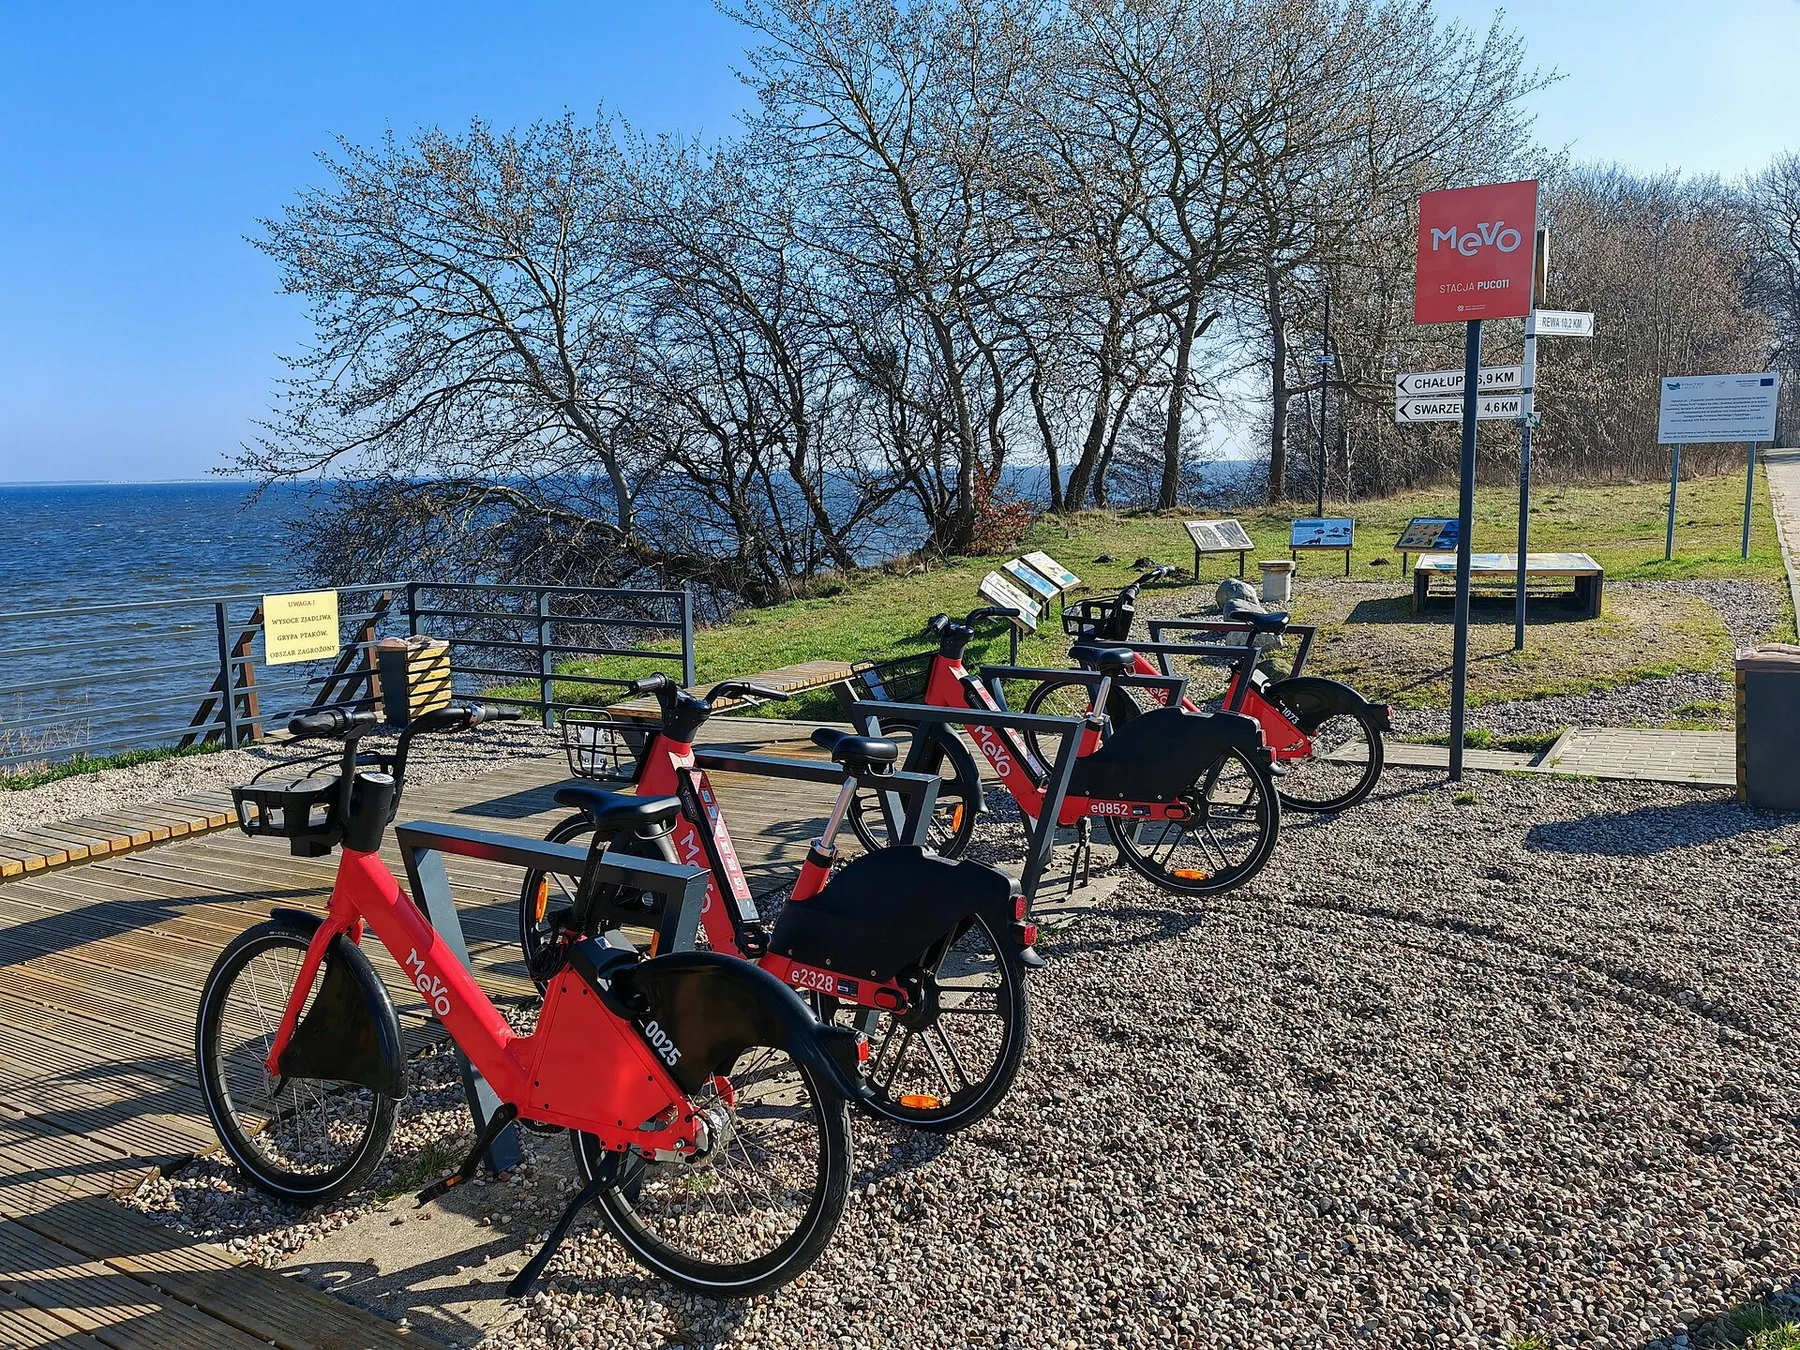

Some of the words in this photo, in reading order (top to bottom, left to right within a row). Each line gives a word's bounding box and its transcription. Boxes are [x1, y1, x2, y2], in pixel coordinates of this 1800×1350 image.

[1439, 281, 1475, 294] STACJA
[1477, 278, 1510, 291] PUC011
[1541, 316, 1560, 328] REWA
[1573, 318, 1583, 329] KM
[1414, 375, 1466, 389] CHAŁUP
[1495, 371, 1514, 383] KM
[1414, 403, 1472, 415] SWARZE
[1484, 402, 1500, 414] 4,6
[1501, 401, 1518, 412] KM
[288, 600, 312, 608] UWAGA
[271, 617, 300, 625] WYSOCE
[300, 614, 332, 624] ZJADLIWA
[276, 633, 299, 641] GRYPA
[269, 649, 296, 659] OBSZAR
[297, 645, 336, 655] ZAGROŻONY
[1281, 706, 1300, 725] 1073
[1090, 802, 1129, 816] e0852
[791, 968, 834, 993] e2328
